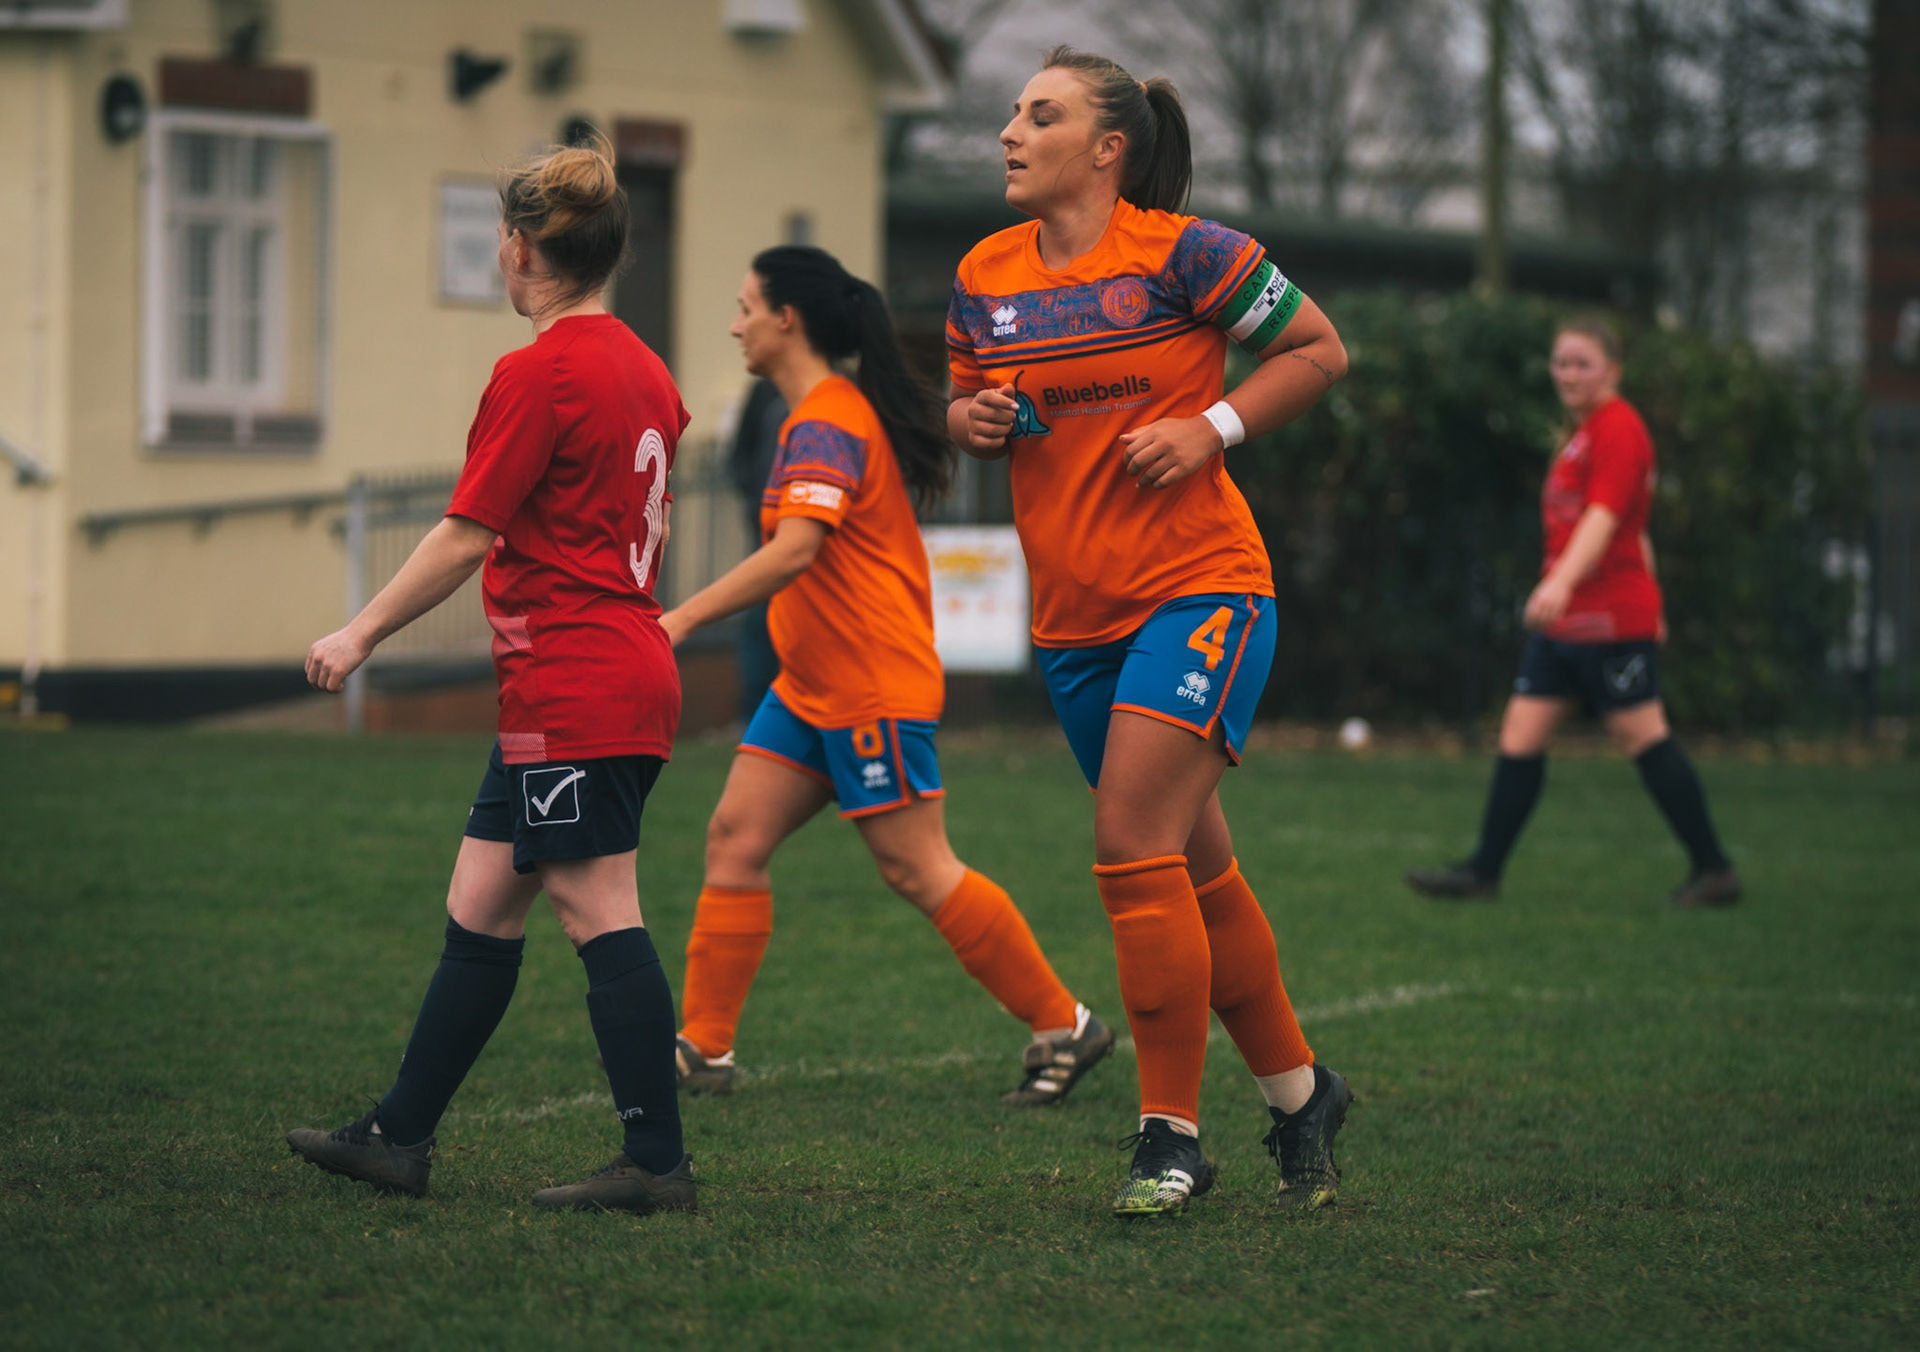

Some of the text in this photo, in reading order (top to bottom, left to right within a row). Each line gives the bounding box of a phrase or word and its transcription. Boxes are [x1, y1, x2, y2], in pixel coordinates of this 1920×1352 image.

[993, 324, 1017, 337] errea
[1043, 375, 1152, 406] Bluebells
[1081, 404, 1112, 415] Health
[630, 428, 667, 588] 3
[1187, 605, 1234, 672] 4
[1176, 686, 1206, 706] errea
